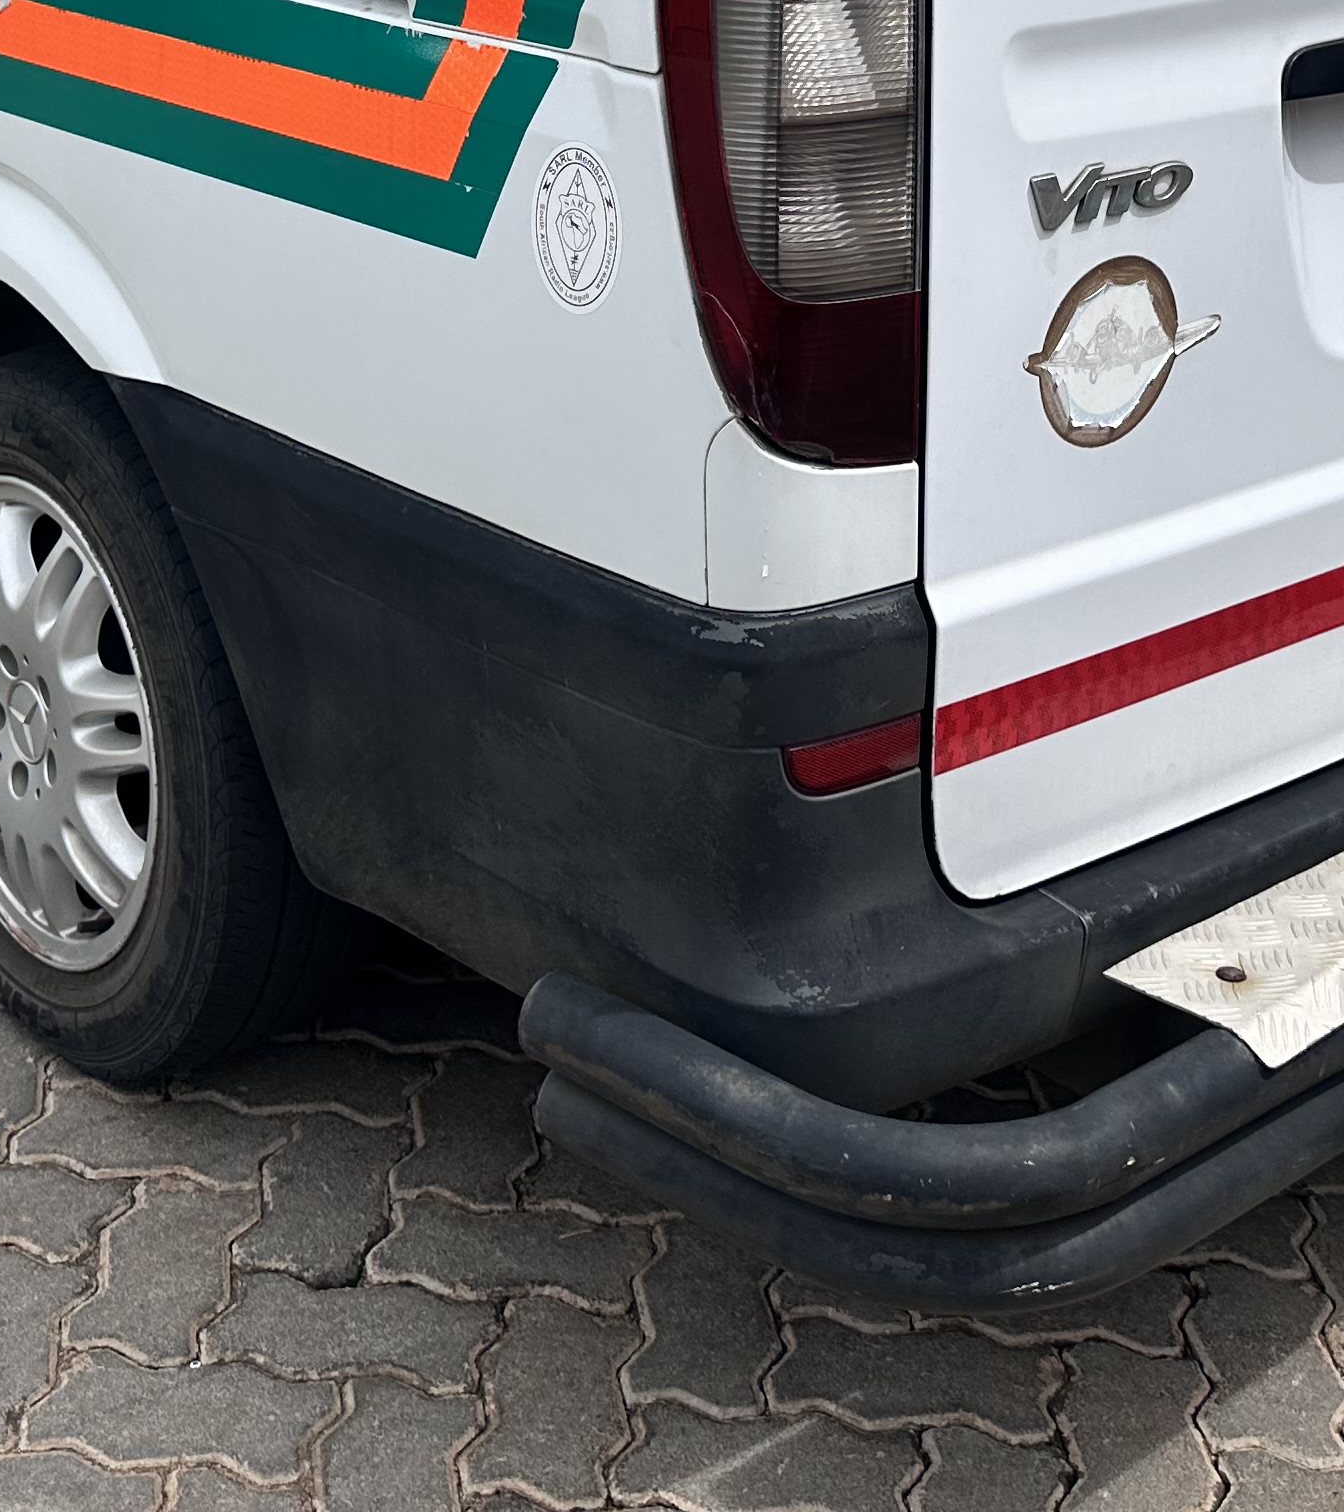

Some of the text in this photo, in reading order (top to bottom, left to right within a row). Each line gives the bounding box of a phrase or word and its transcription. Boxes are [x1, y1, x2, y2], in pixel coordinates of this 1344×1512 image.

[549, 151, 607, 187] SARL Member
[564, 199, 590, 215] SARL
